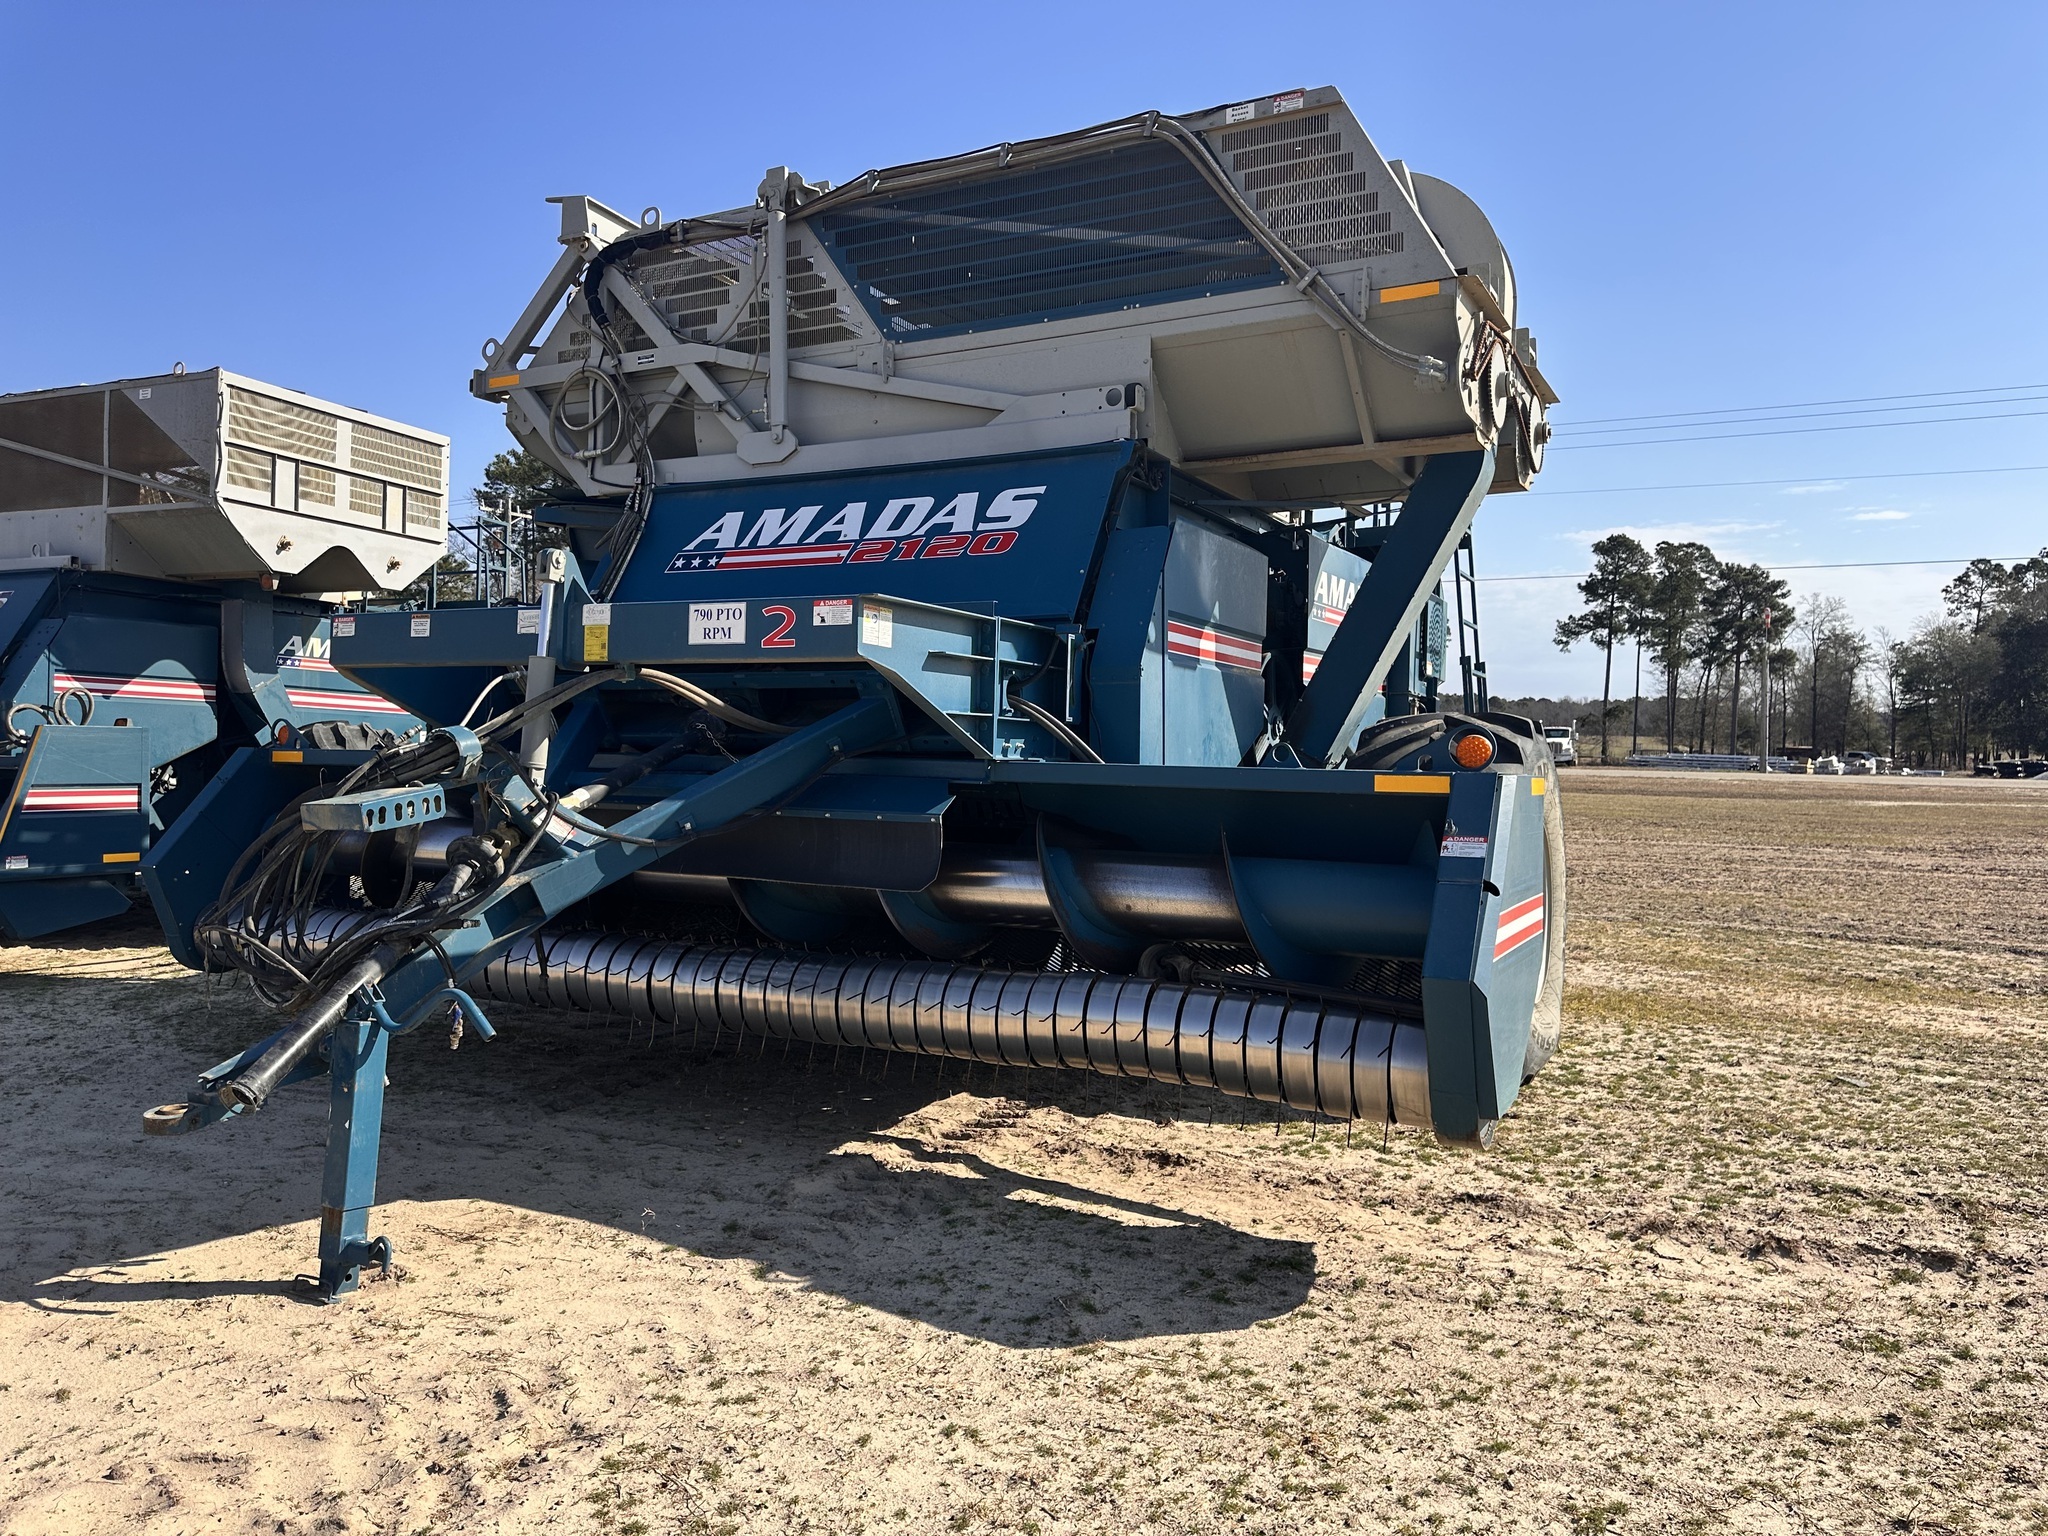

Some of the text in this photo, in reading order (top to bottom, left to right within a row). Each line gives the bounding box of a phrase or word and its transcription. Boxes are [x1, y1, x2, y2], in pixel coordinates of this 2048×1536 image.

[1281, 92, 1301, 100] DANGER
[683, 485, 1048, 550] AMADAS
[847, 531, 1019, 564] 2120
[1314, 570, 1360, 610] AMA
[694, 607, 742, 621] 790 PTO
[761, 604, 796, 649] 2
[703, 627, 732, 640] RPM
